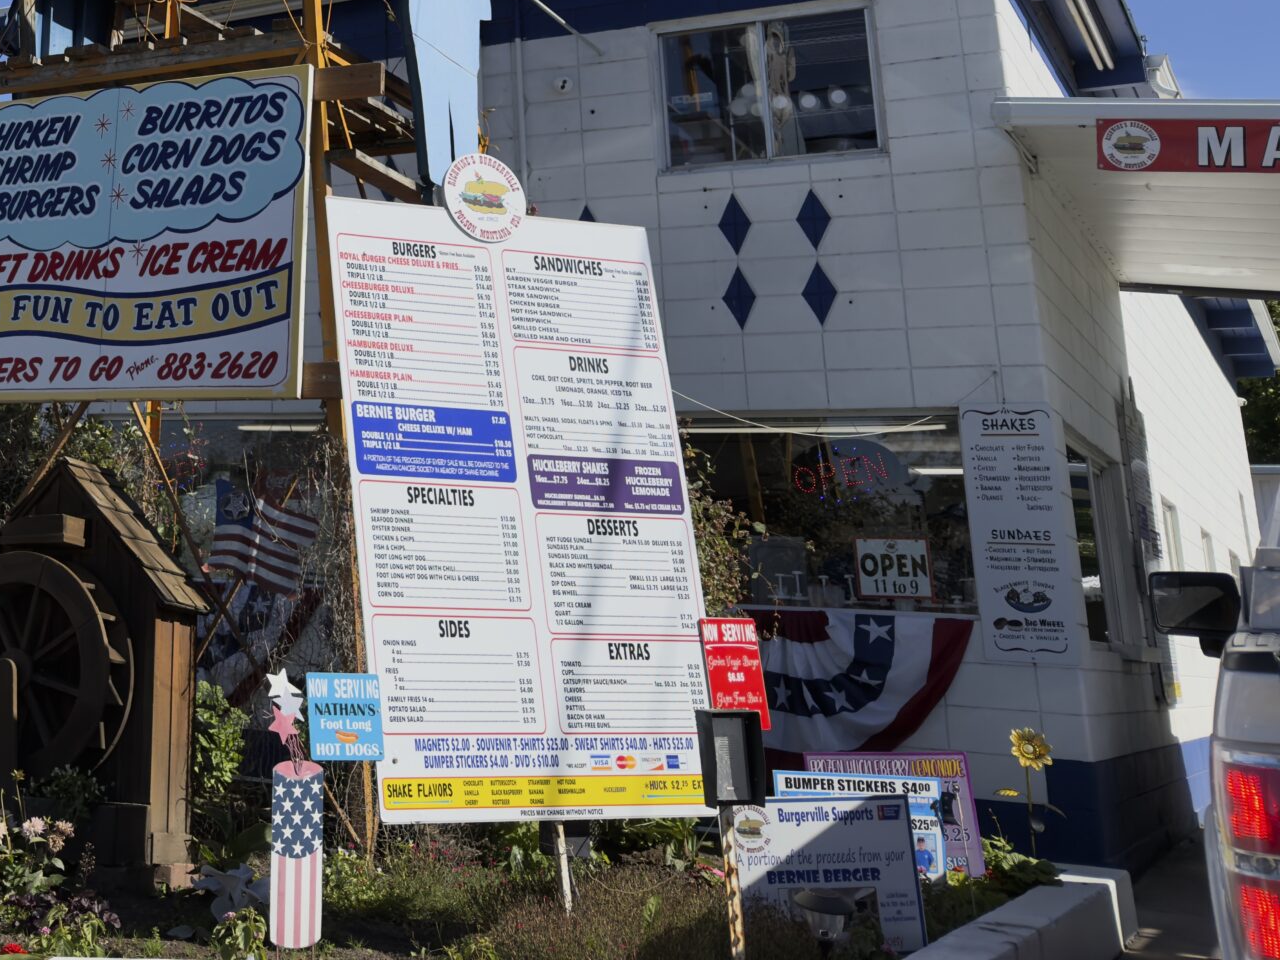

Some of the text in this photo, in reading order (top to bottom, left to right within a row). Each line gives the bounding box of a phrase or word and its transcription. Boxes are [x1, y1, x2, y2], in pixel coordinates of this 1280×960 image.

[138, 91, 287, 137] BURRITOS
[121, 129, 287, 175] CORN DOGS
[129, 171, 246, 210] SALADS
[138, 237, 289, 277] ICE CREAM
[392, 241, 437, 259] BURGERS
[27, 246, 125, 283] DRINKS
[339, 251, 459, 271] ROYAL BURGER CHEESE DELUXE FRIES
[534, 255, 603, 277] SANDWICHES
[341, 280, 415, 295] CHEESEBURGER DELUXE
[11, 294, 73, 324] FUN
[85, 301, 120, 332] TO
[133, 297, 198, 332] EAT
[210, 279, 279, 323] OUT
[344, 310, 413, 323] CHEESEBURGER PLAIN
[347, 339, 414, 352] HAMBURGER DELUXE
[49, 356, 82, 383] TO
[88, 355, 124, 382] GO
[157, 351, 279, 381] 883-2620
[569, 355, 609, 374] DRINKS
[356, 404, 436, 423] BERNIE BURGER
[398, 422, 420, 432] CHEESE
[982, 418, 1036, 432] SHAKES
[532, 459, 609, 475] HUCKLEBERRY SHAKES
[634, 466, 661, 476] FROZEN
[794, 452, 888, 493] OPEN
[625, 476, 673, 487] HUCKLEBERRY
[407, 486, 475, 507] SPECIALTIES
[631, 486, 670, 497] LEMONADE
[587, 518, 639, 537] DESSERTS
[991, 529, 1051, 541] SUNDAES
[860, 552, 928, 578] OPEN
[873, 579, 919, 595] 11 to 9
[438, 619, 471, 639] SIDES
[702, 623, 756, 642] NOW SERVING
[608, 642, 651, 661] EXTRAS
[308, 678, 380, 699] NOW SERVING
[314, 703, 376, 716] NATHAN'S
[320, 719, 372, 732] Foot Long
[316, 743, 380, 756] HOT DOGS
[415, 737, 694, 752] MAGNETS $2.00 SOUVENIR T-SHIRTS $25.00 SWEAT SHIRTS $40.00 HATS $25.00
[424, 755, 454, 769] BUMPER
[455, 755, 488, 769] STICKERS
[489, 754, 509, 768] $4.00
[537, 754, 560, 768] $10.00
[910, 759, 965, 778] LEMONADE
[387, 782, 454, 799] SHAKE FLAVORS
[785, 777, 834, 791] BUMPER
[836, 778, 896, 793] STICKERS
[777, 807, 830, 827] Burgerville
[831, 806, 874, 826] Supports
[736, 846, 906, 871] A portion of the proceeds from your
[767, 867, 881, 885] BERNIE BERGER
